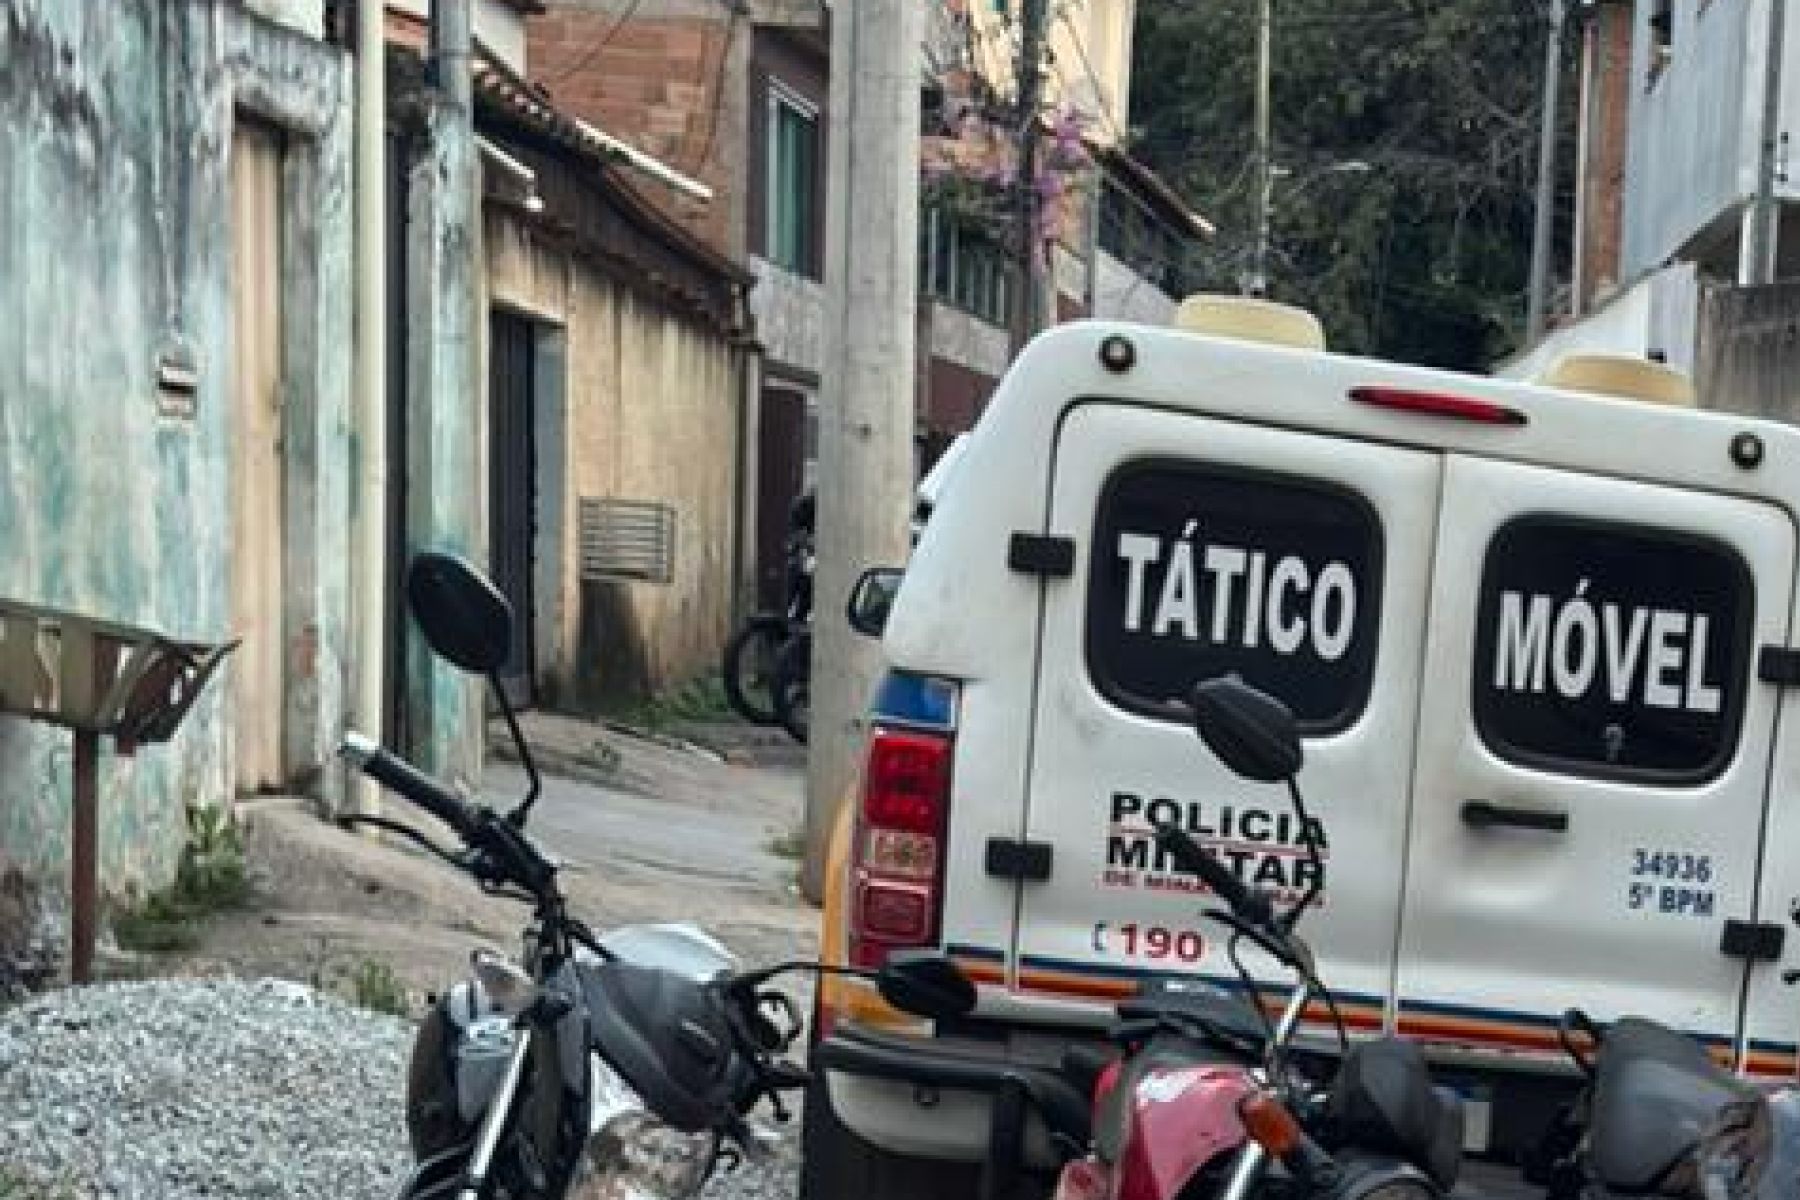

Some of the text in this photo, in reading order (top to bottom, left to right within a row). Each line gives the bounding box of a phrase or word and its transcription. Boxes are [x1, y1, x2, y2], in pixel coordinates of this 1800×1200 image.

[1118, 518, 1356, 662] TÁTICO
[1495, 578, 1720, 712] MÓVEL
[1105, 836, 1326, 891] MITAR
[1659, 885, 1713, 917] BPM
[1121, 922, 1204, 963] 190
